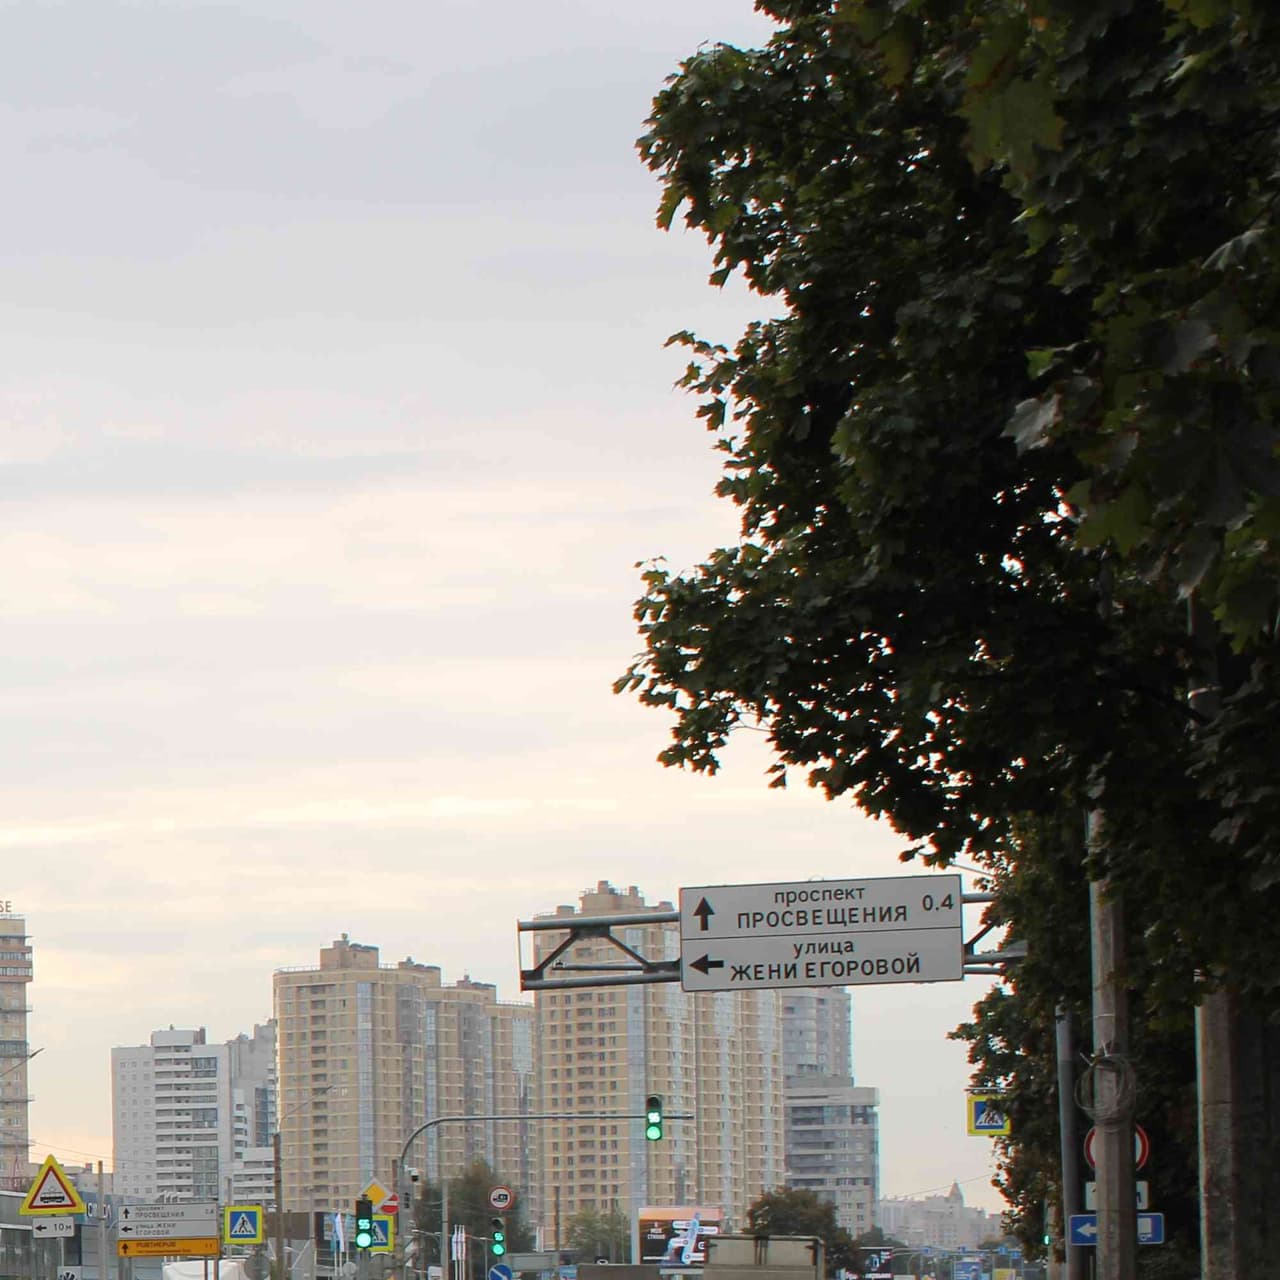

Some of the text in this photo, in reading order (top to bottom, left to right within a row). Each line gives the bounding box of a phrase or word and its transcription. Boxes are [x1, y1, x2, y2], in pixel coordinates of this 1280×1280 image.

[774, 887, 865, 906] проспект
[922, 894, 954, 911] 0.4
[738, 905, 908, 929] ПРОСВЕЩЕНИЯ
[793, 940, 854, 959] улица
[730, 952, 920, 982] ЖЕНИ ЕГОРОВОЙ
